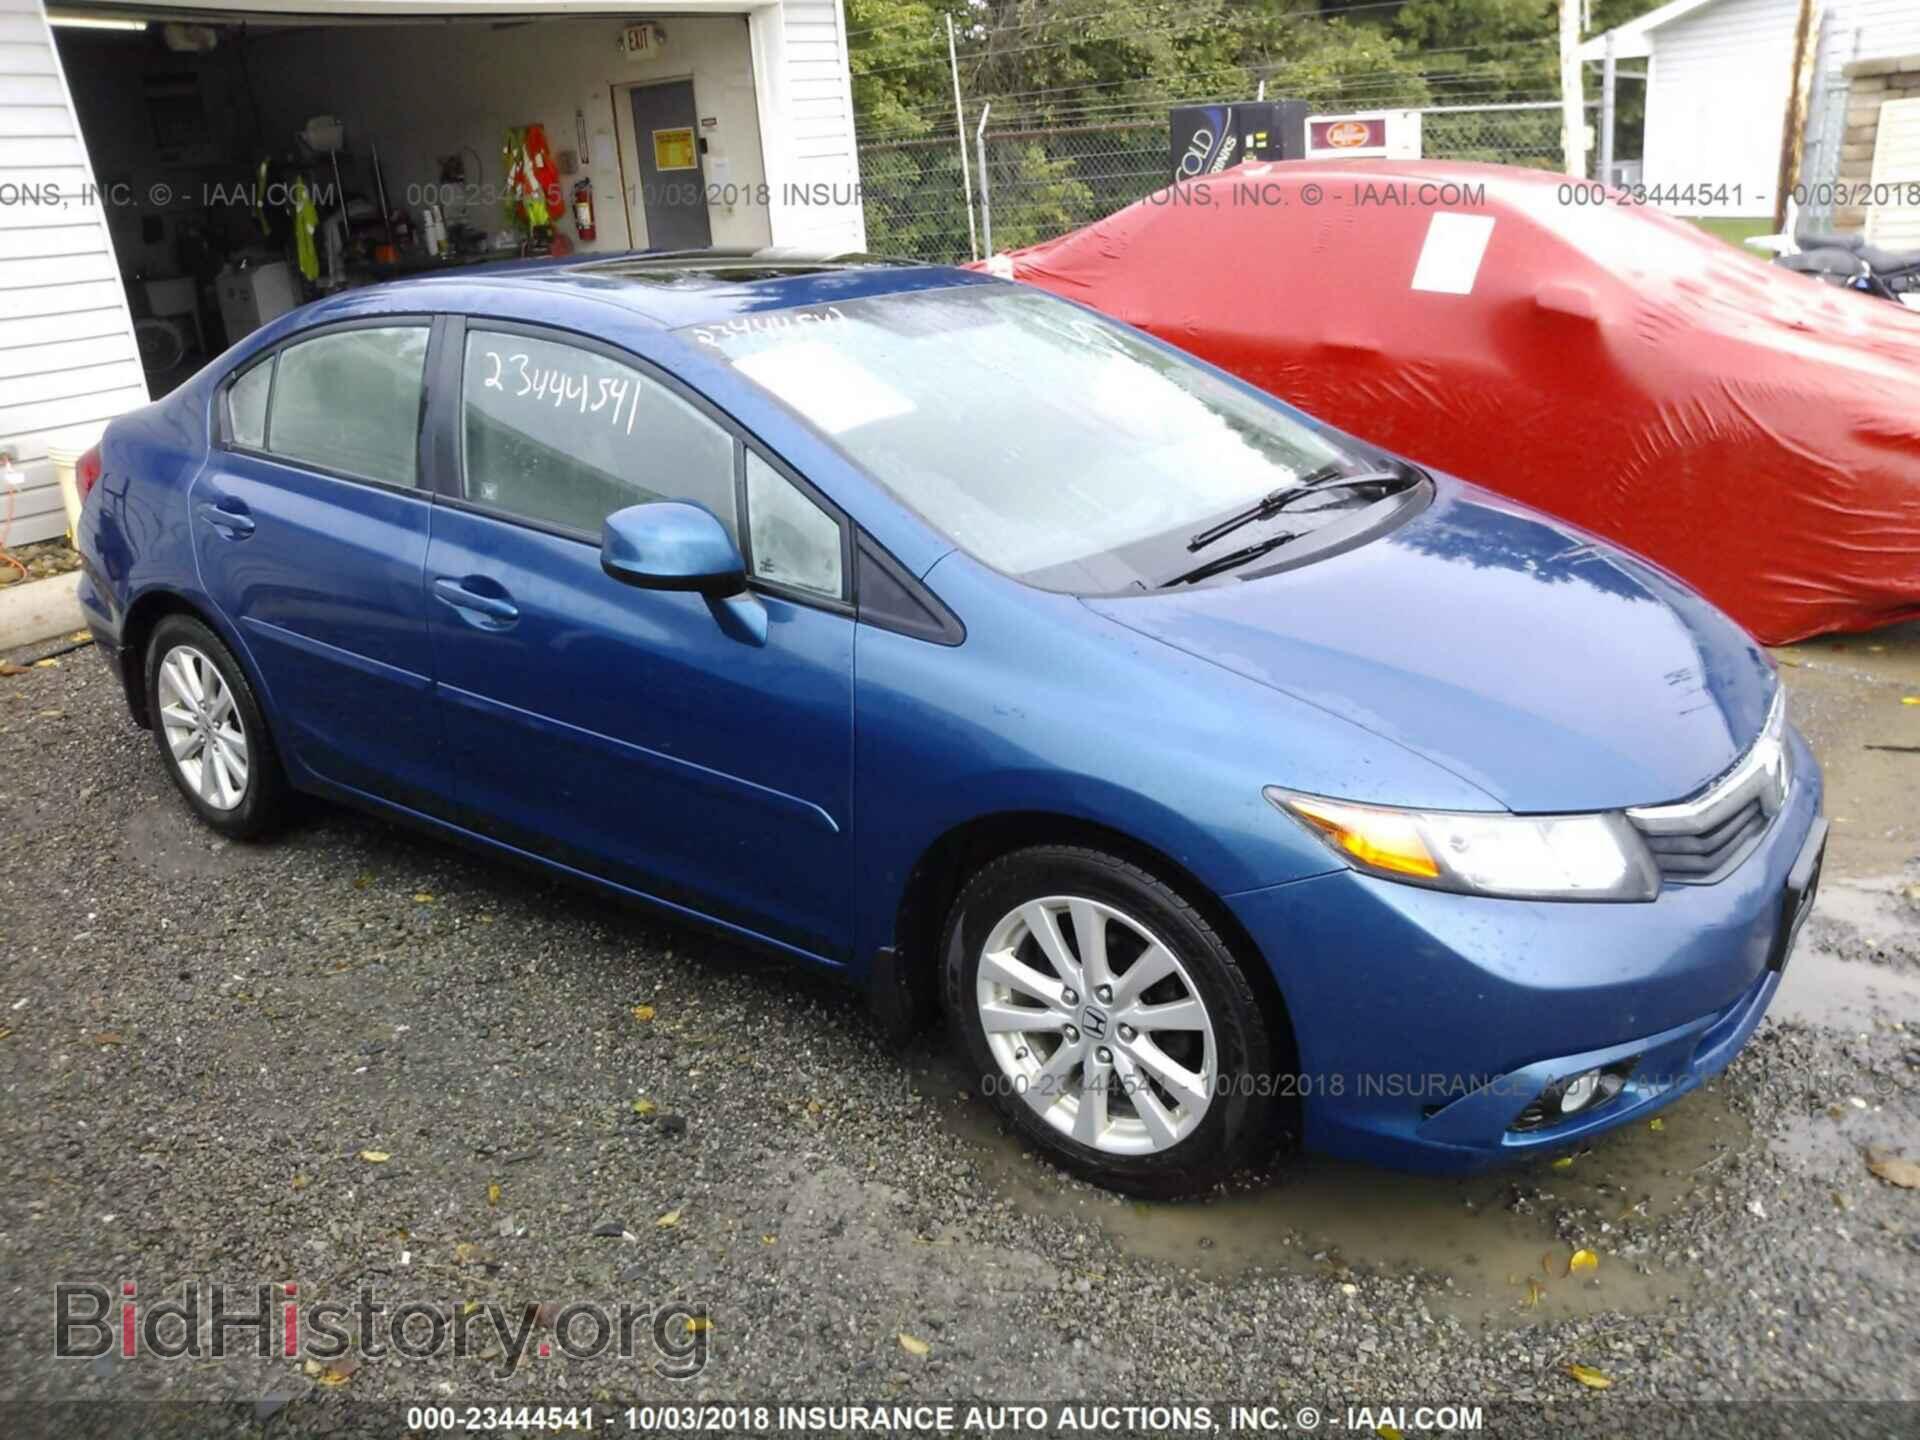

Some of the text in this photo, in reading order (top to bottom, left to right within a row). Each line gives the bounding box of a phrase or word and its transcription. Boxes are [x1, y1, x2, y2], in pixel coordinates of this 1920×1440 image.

[627, 27, 649, 51] EXIT
[1210, 135, 1237, 174] RINKS
[484, 351, 641, 436] 23444541
